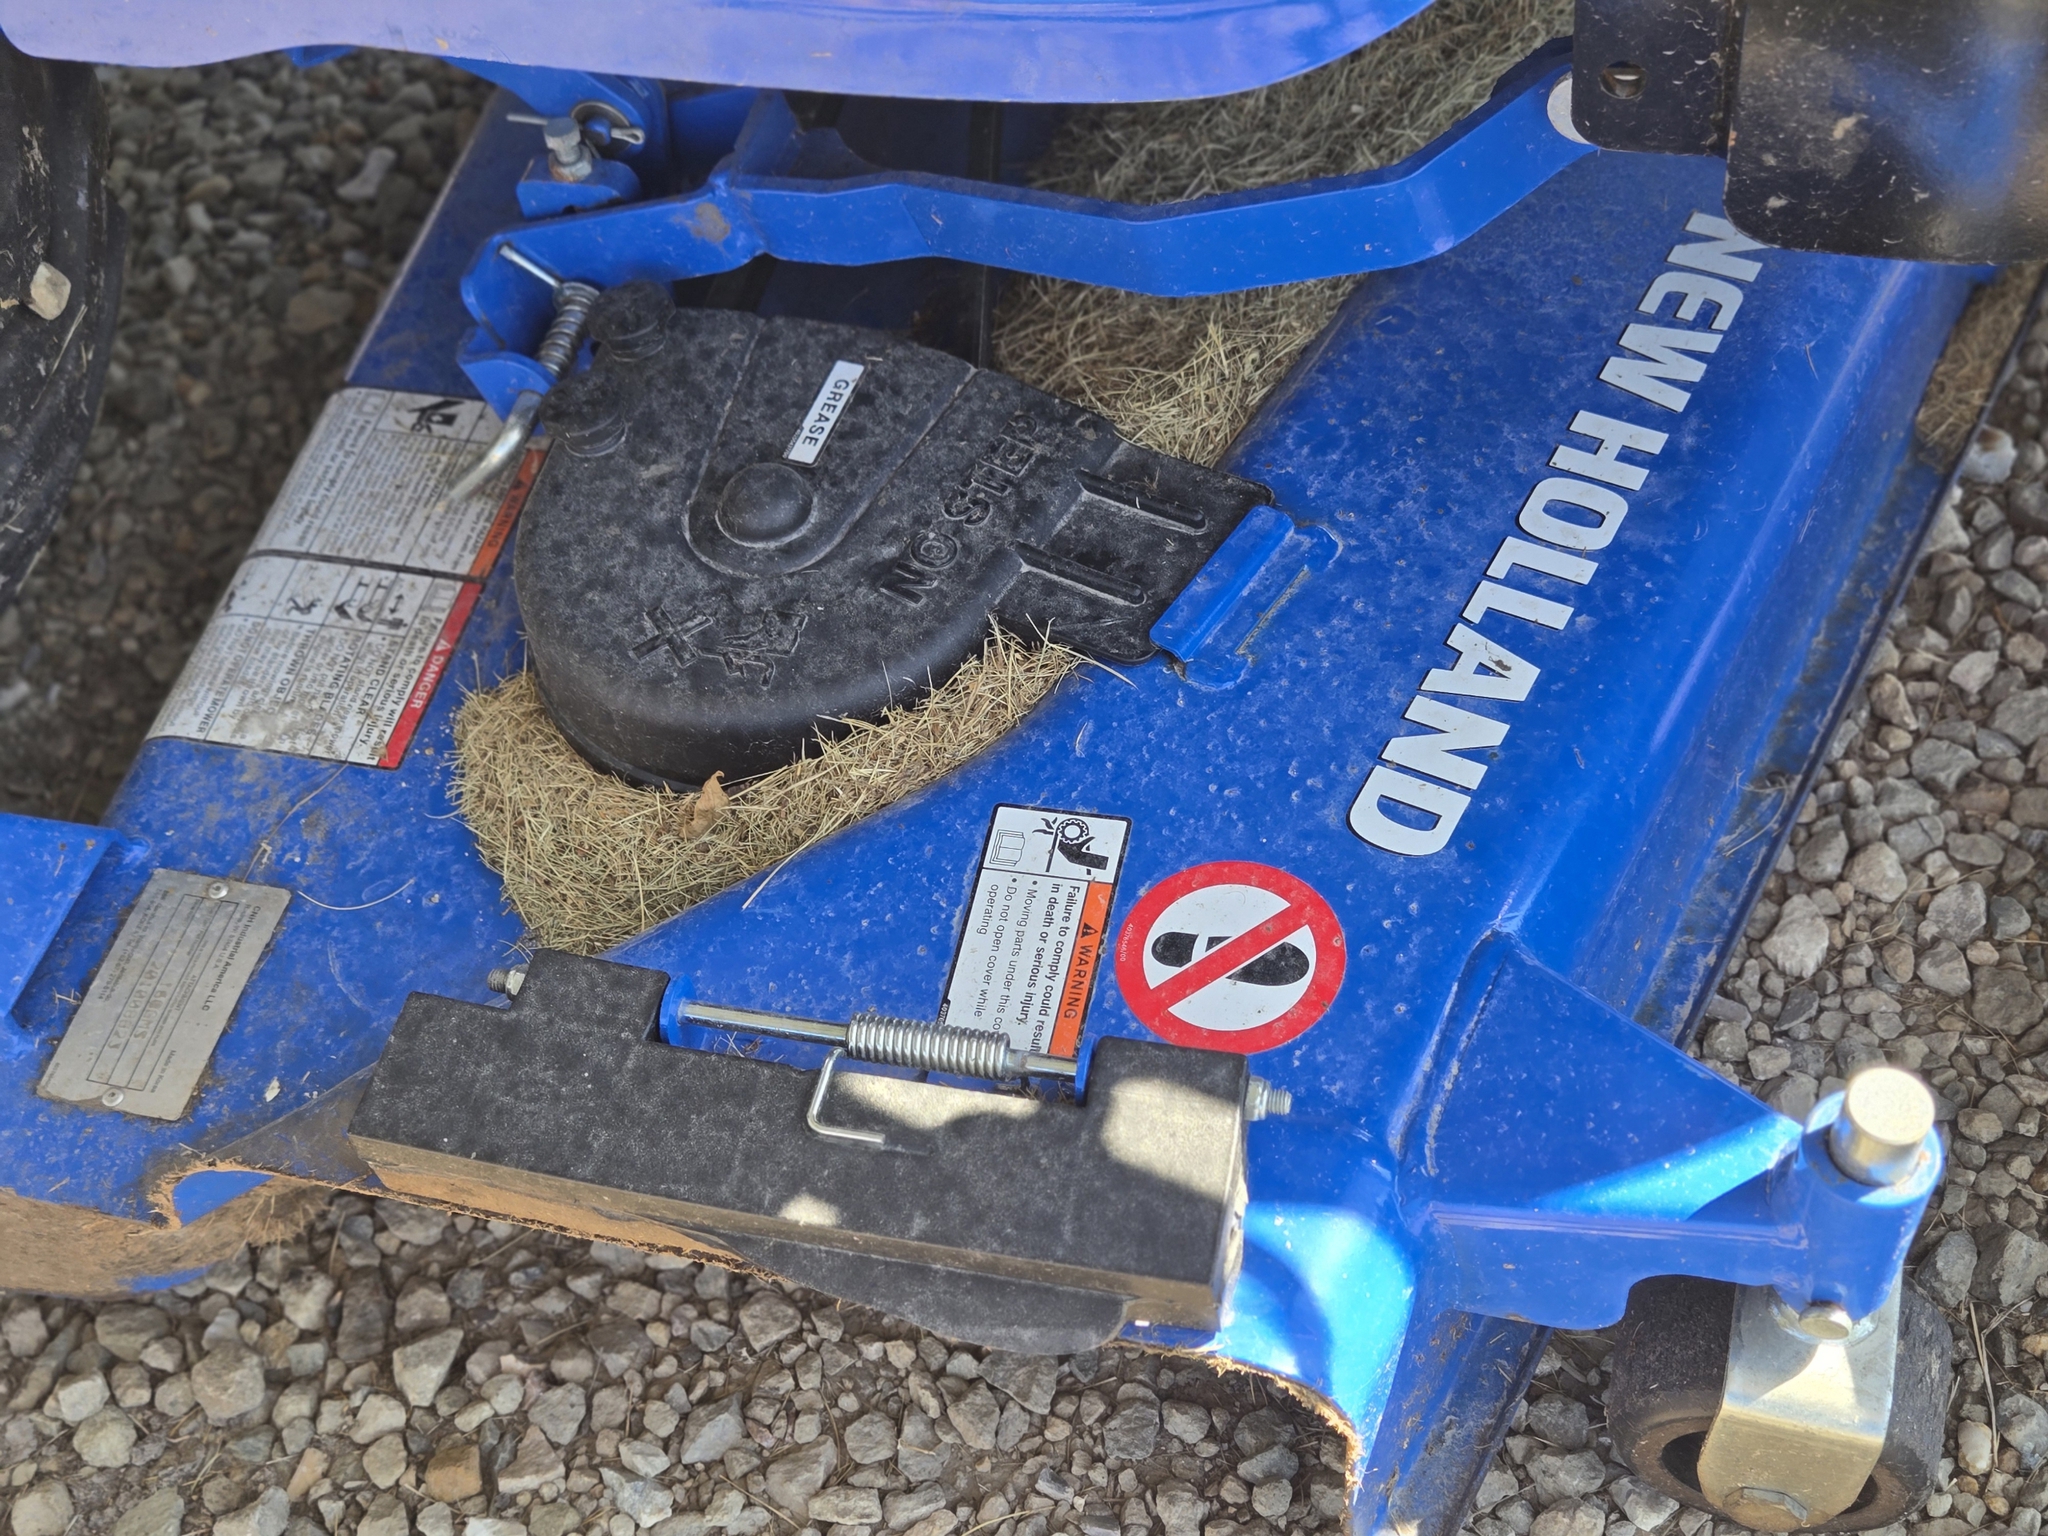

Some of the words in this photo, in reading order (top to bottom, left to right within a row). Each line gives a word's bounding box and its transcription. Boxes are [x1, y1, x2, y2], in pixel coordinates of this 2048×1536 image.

[1600, 211, 1763, 413] NEW
[799, 377, 851, 447] GREASE
[484, 494, 524, 548] WARNING
[879, 528, 959, 606] NO
[284, 628, 316, 674] THROWN
[1346, 410, 1669, 857] HOLLAND
[328, 635, 362, 689] ROTATING
[373, 640, 399, 676] STAND
[396, 658, 408, 669] or
[355, 678, 380, 715] CLEAR
[375, 672, 401, 711] serious
[390, 667, 417, 705] comply
[409, 654, 444, 708] DANGER
[194, 698, 221, 733] MOWER
[383, 708, 398, 727] will
[1004, 886, 1016, 901] Do
[1050, 883, 1062, 893] in
[1060, 885, 1080, 922] Failure
[246, 905, 261, 922] CNH
[977, 884, 1000, 935] operating
[998, 904, 1011, 921] not
[1017, 888, 1036, 927] Moving
[1042, 896, 1059, 928] death
[227, 924, 251, 959] Industrial
[988, 924, 1004, 951] open
[1010, 930, 1026, 957] parts
[1037, 931, 1049, 943] or
[1057, 926, 1070, 937] to
[210, 961, 232, 992] America
[981, 955, 997, 985] cover
[1001, 959, 1019, 991] under
[1026, 946, 1046, 988] serious
[1044, 940, 1065, 981] comply
[1063, 944, 1092, 1020] WARNING
[200, 994, 215, 1011] LLC
[973, 987, 990, 1017] while
[995, 994, 1010, 1013] this
[1015, 991, 1035, 1026] injury.
[1037, 984, 1055, 1017] could
